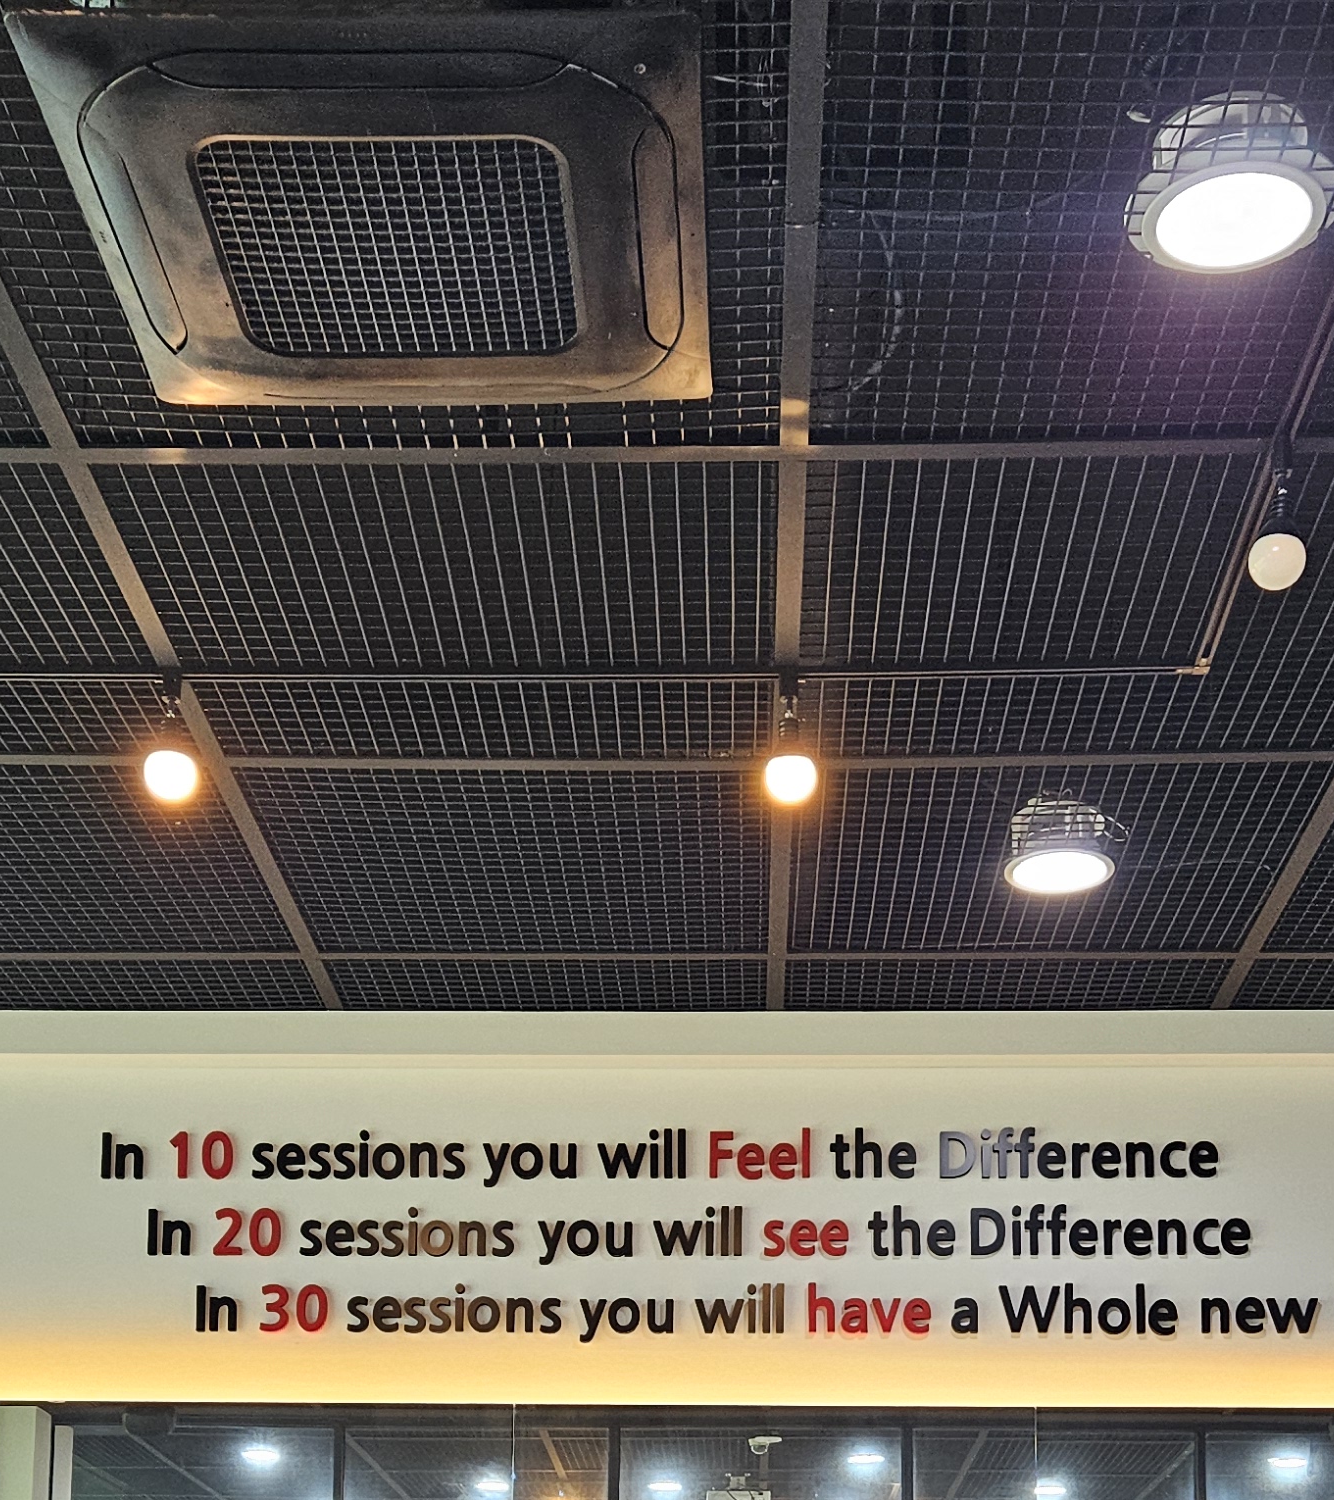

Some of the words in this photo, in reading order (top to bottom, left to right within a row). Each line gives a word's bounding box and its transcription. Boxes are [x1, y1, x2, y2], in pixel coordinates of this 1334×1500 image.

[101, 1131, 144, 1180] In
[170, 1131, 235, 1180] 10
[252, 1129, 466, 1180] sessions
[483, 1141, 578, 1188] you
[598, 1128, 687, 1180] will
[709, 1128, 811, 1180] Feel
[830, 1127, 917, 1180] the
[939, 1127, 1219, 1180] Difference
[147, 1208, 192, 1257] In
[213, 1208, 282, 1257] 20
[299, 1206, 515, 1257] sessions
[538, 1219, 634, 1266] you
[653, 1206, 743, 1257] will
[763, 1217, 850, 1257] see
[867, 1204, 956, 1257] the
[970, 1204, 1251, 1257] Difference
[196, 1285, 238, 1333] In
[259, 1284, 329, 1333] 30
[347, 1283, 562, 1334] sessions
[579, 1297, 674, 1344] you
[695, 1283, 785, 1334] will
[807, 1282, 932, 1335] have
[951, 1297, 979, 1335] a
[999, 1282, 1179, 1336] Whole
[1201, 1295, 1319, 1335] new
